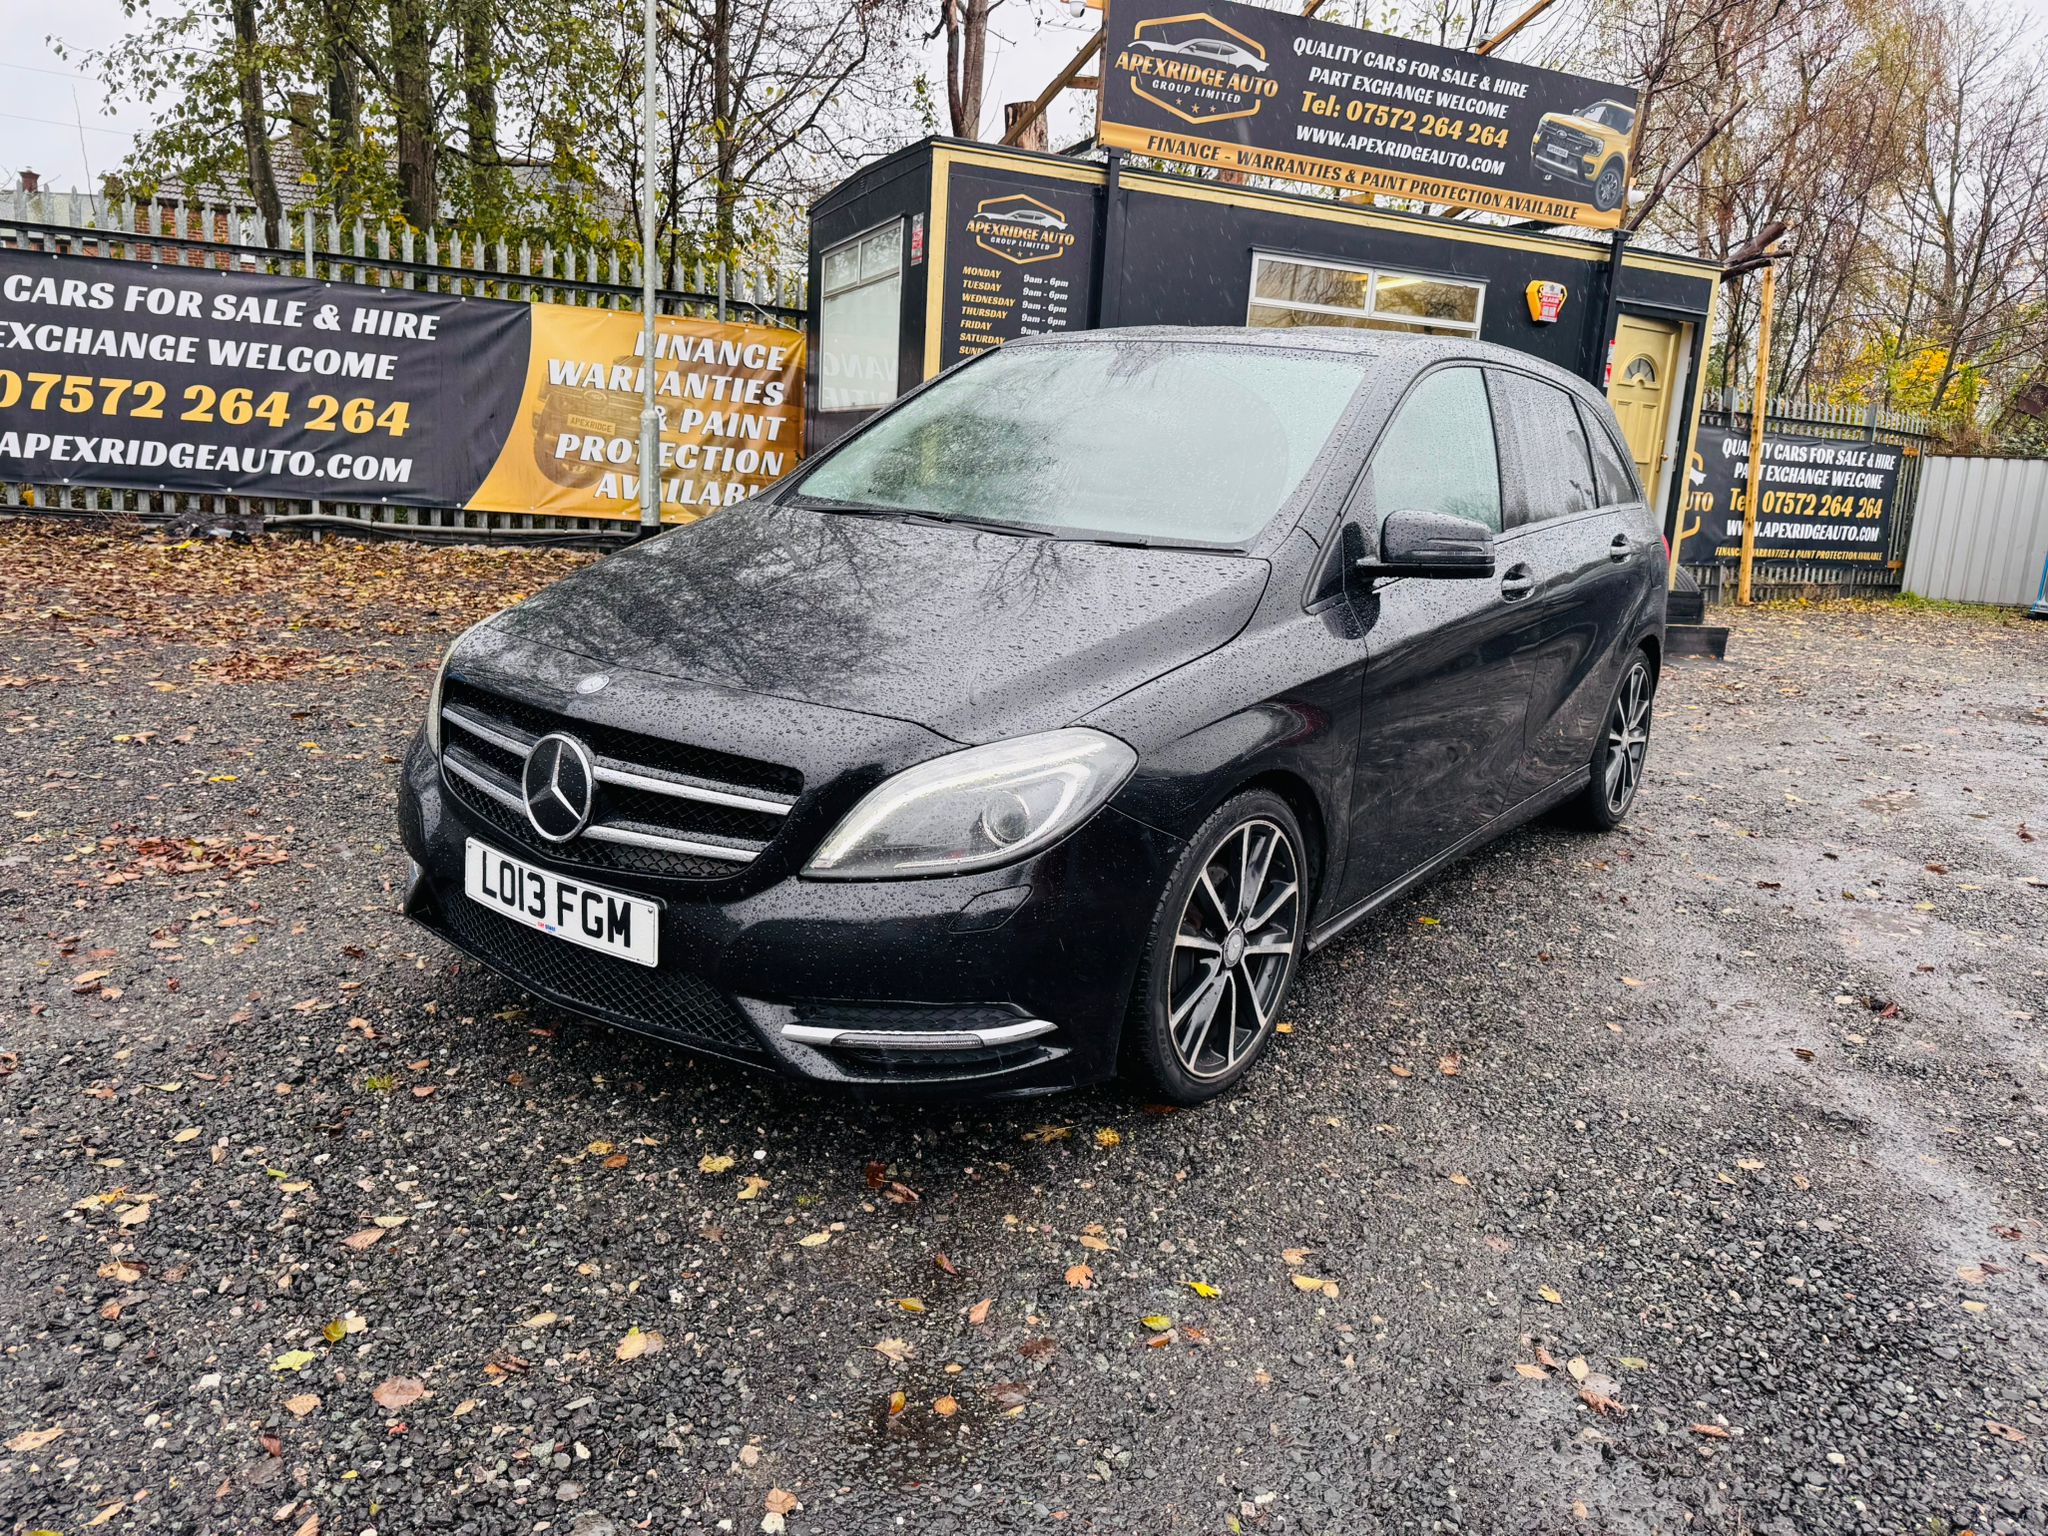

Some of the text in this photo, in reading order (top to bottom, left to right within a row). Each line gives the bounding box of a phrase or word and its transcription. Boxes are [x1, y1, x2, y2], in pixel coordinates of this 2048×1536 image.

[1114, 51, 1279, 98] APEXRIDGE AUTO
[1293, 37, 1529, 98] QUALITY CARS FOR SALE & HIRE
[1152, 79, 1241, 104] GROUP LIMITED
[1308, 66, 1509, 120] PART EXCHANGE WELCOME
[1301, 91, 1510, 149] Tel: 07572 264 264
[1296, 125, 1506, 176] WWW.APEXRIDGEAUTO.COM
[1147, 135, 1221, 162] FINANCE
[1236, 150, 1342, 181] WARRANTIES
[1345, 169, 1356, 184] &
[1361, 171, 1408, 194] PAINT
[1409, 179, 1501, 208] PROTECTION
[1503, 196, 1580, 221] AVAILABLE
[966, 219, 1075, 247] APEXRIDGE AUTO
[990, 236, 1050, 251] GROUP LIMITED
[962, 266, 1002, 279] MONDAY
[1023, 274, 1043, 284] 9am
[1049, 277, 1069, 288] 6pm
[962, 279, 1002, 292] TUESDAY
[1022, 287, 1043, 297] 9am
[1049, 290, 1068, 301] 6pm
[3, 274, 441, 341] CARS FOR SALE & HIRE
[961, 306, 1008, 319] THURSDAY
[1021, 313, 1040, 323] 9am
[1047, 316, 1066, 326] 6pm
[962, 293, 1015, 308] WEDNESDAY
[1022, 300, 1041, 310] 9am
[1048, 303, 1067, 314] 6pm
[960, 319, 992, 330] FRIDAY
[960, 332, 1005, 345] SATURDAY
[207, 338, 399, 381] WELCOME
[0, 369, 411, 437] 07572 264 264
[680, 408, 787, 441] PAINT
[0, 431, 413, 484] APEXRIDGEAUTO.COM
[554, 433, 784, 476] PROECTION
[1774, 444, 1808, 463] CARS
[1809, 448, 1834, 464] FOR
[1835, 451, 1866, 468] SALE
[1866, 455, 1875, 468] &
[1875, 454, 1896, 471] HIRE
[1733, 462, 1884, 490] PAT EXCHANGE WELCOME
[1762, 490, 1817, 517] 07572
[1818, 494, 1853, 518] 264
[1855, 497, 1883, 519] 264
[1715, 546, 1740, 557] FINANC
[1755, 548, 1789, 558] ARRANTIES
[1796, 549, 1815, 559] PAINT
[1815, 550, 1858, 561] PROTECTION
[482, 851, 632, 948] LO13 FGM
